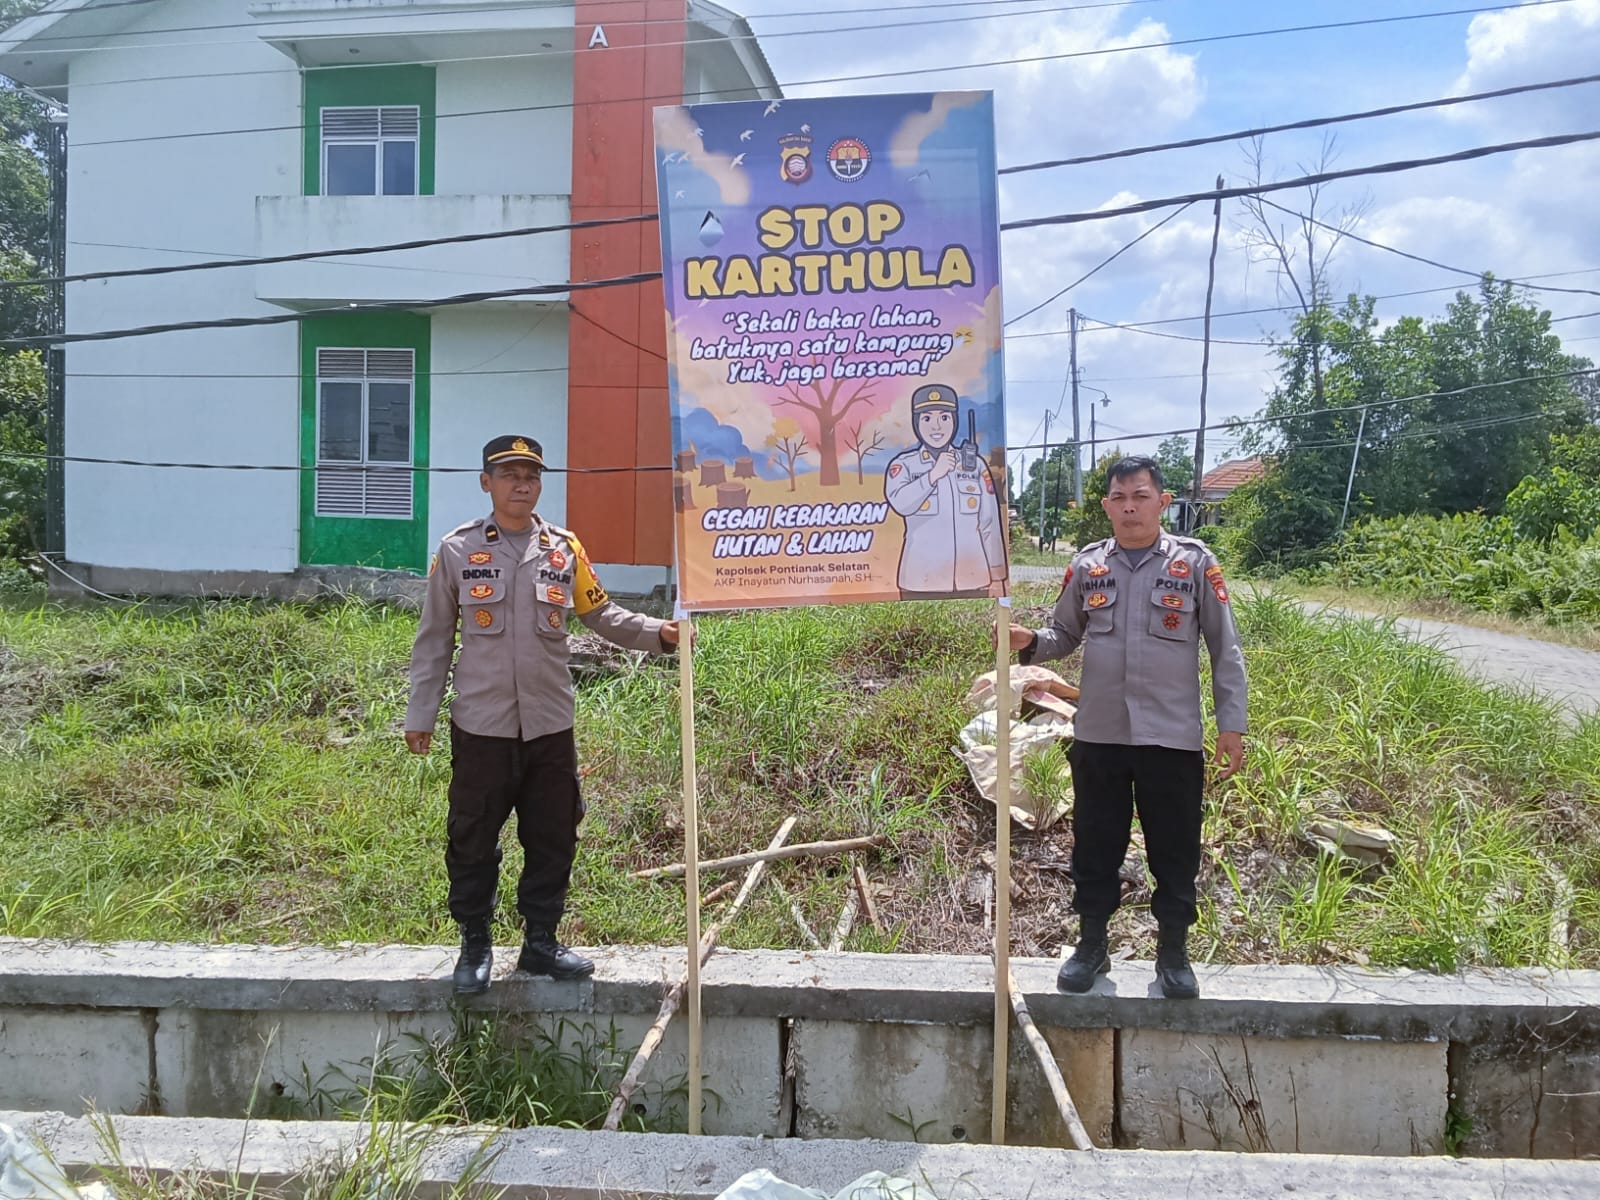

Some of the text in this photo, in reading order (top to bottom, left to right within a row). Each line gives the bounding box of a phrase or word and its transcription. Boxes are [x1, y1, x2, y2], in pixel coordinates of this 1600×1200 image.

[588, 24, 609, 48] A
[757, 201, 903, 250] STOP
[685, 246, 974, 298] KARTHULA
[805, 307, 863, 330] bakar
[871, 305, 940, 328] lahan,
[691, 331, 953, 362] batuknya satu kampung
[727, 360, 771, 384] Yuk,
[775, 360, 825, 385] jaga
[702, 502, 888, 531] CEGAH KEBAKARAN
[713, 530, 872, 558] HUTAN & LAHAN
[540, 569, 571, 585] POLRI
[714, 577, 736, 587] AKP
[738, 576, 786, 588] Inayatun
[788, 574, 853, 585] Nurhasanah,
[716, 562, 870, 577] Kapolsek Pontianak Selatan
[1156, 578, 1193, 592] POLRI
